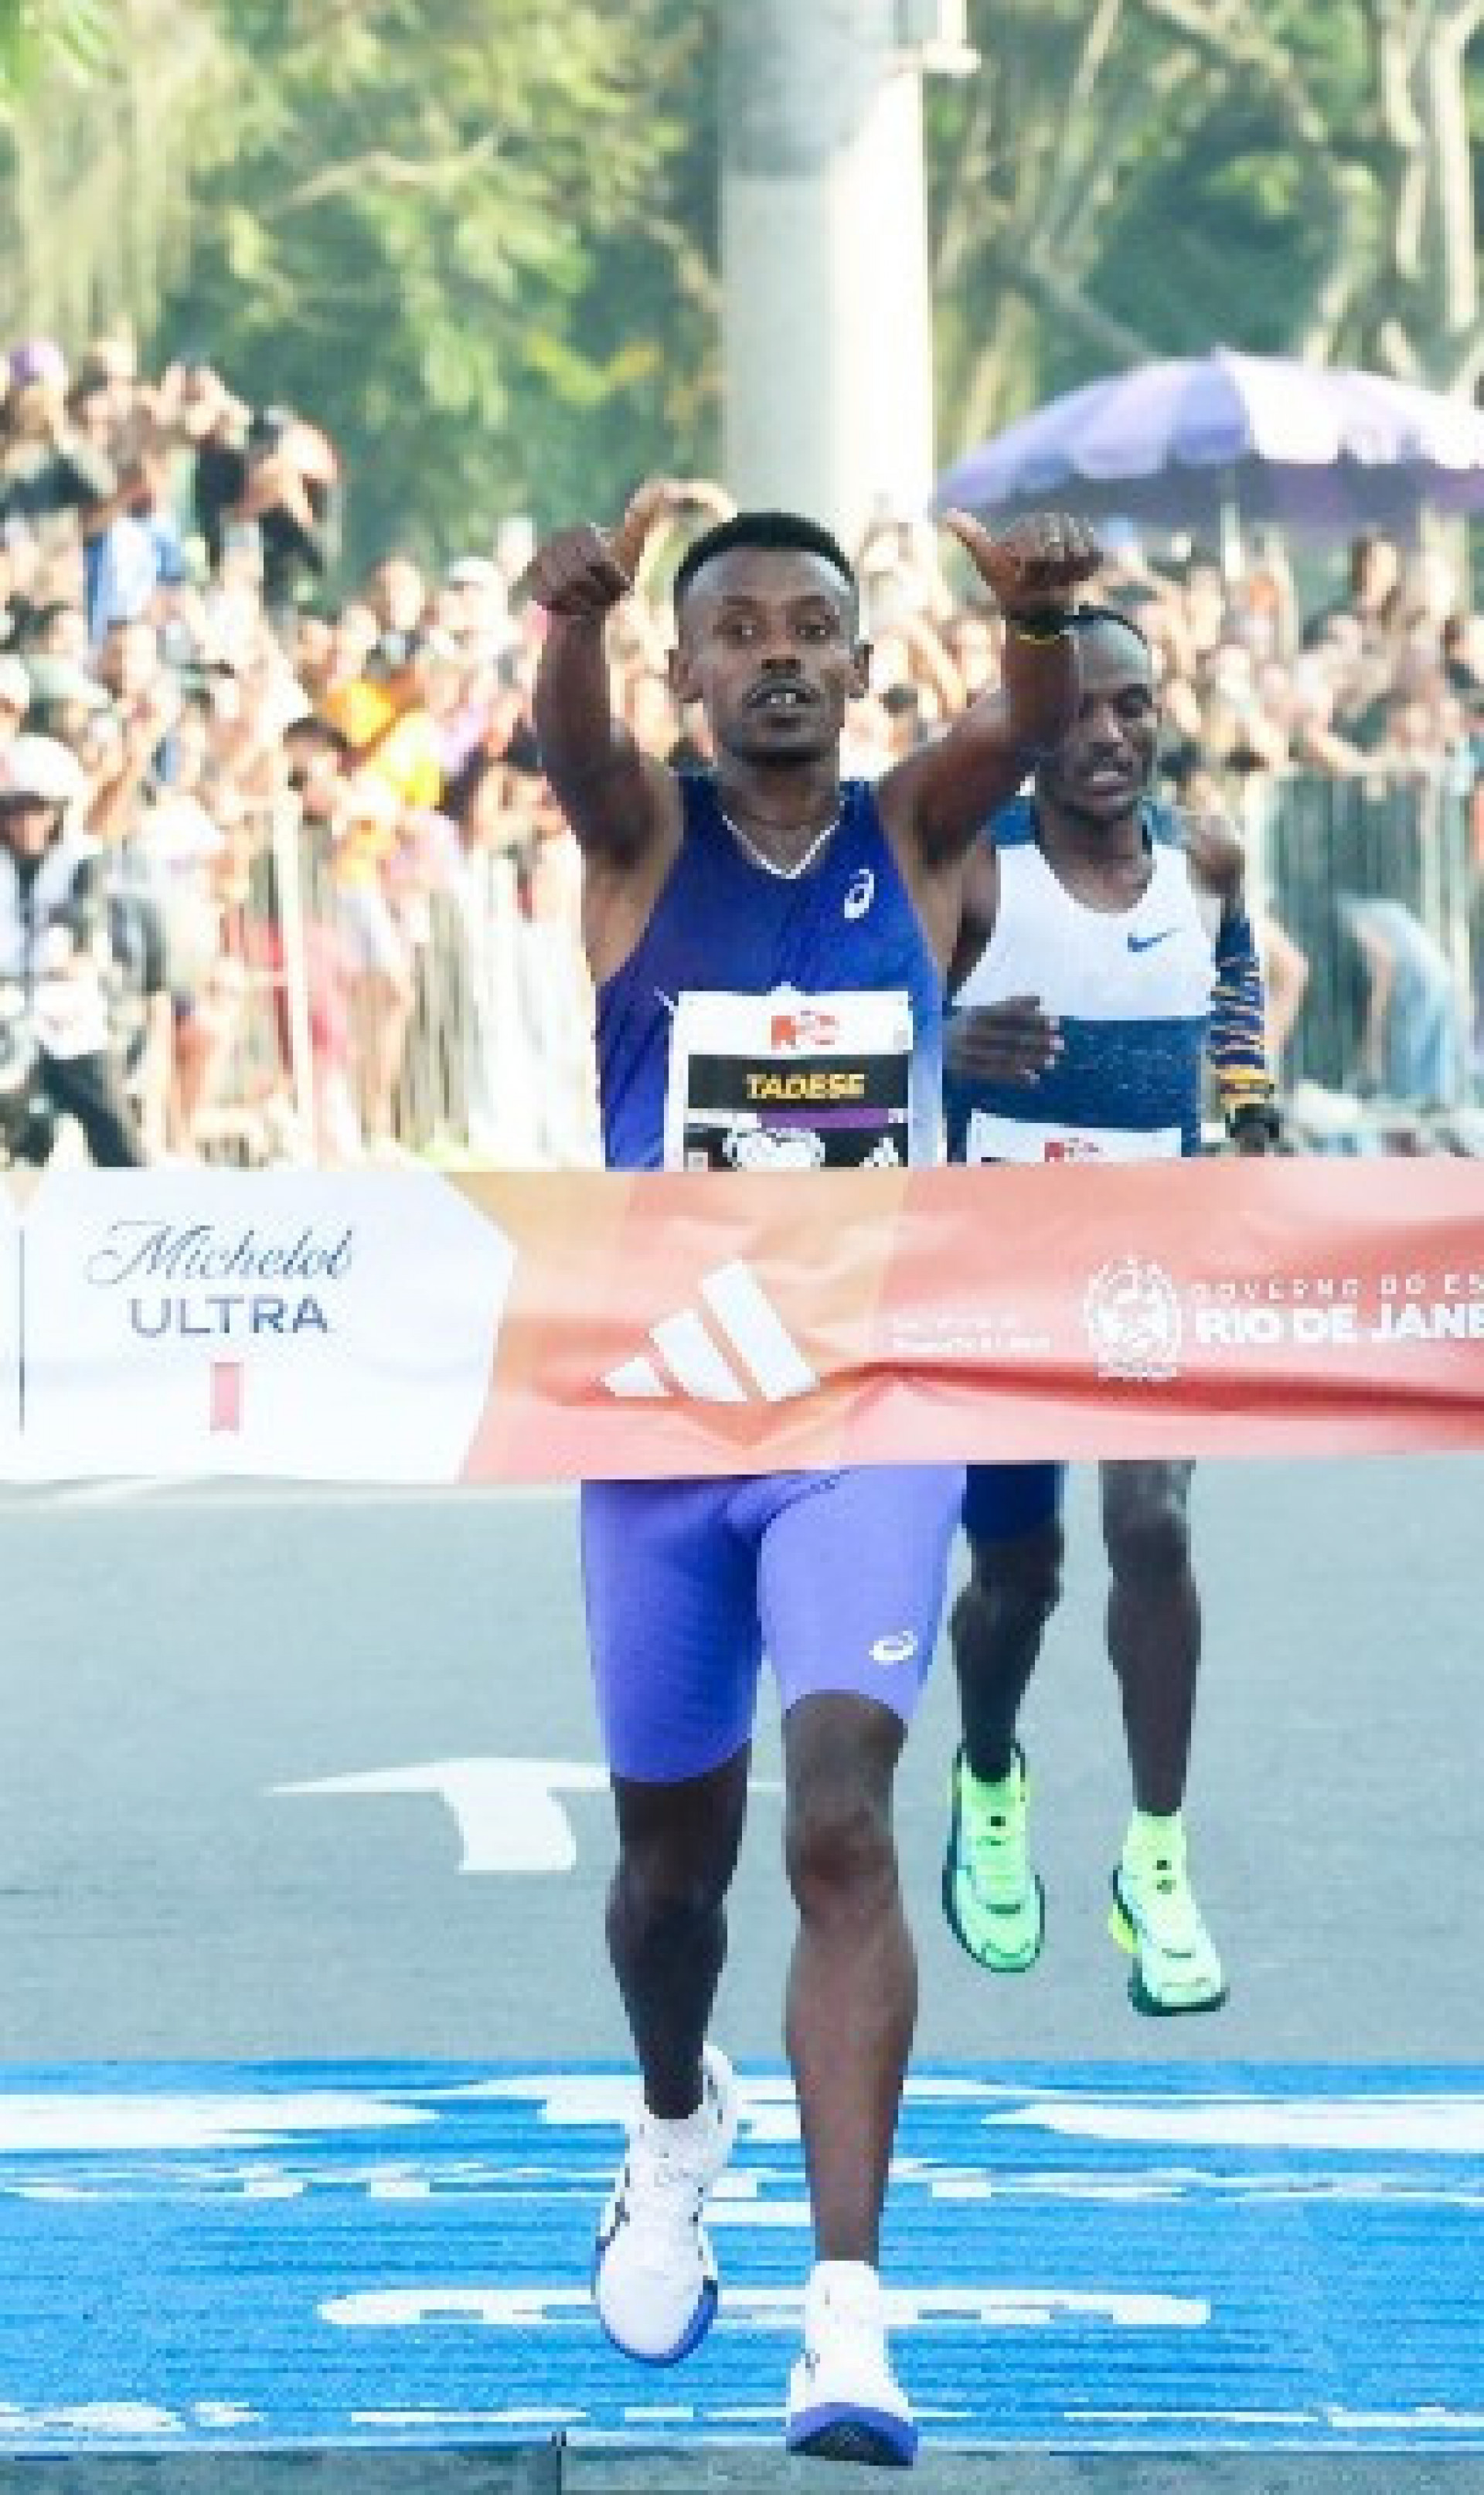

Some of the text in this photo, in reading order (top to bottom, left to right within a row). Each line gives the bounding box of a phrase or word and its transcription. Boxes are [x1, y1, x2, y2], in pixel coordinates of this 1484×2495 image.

[745, 1073, 865, 1099] TADESE
[130, 1294, 329, 1338] ULTRA
[1195, 1308, 1283, 1344] RIO
[1292, 1306, 1358, 1343] DE
